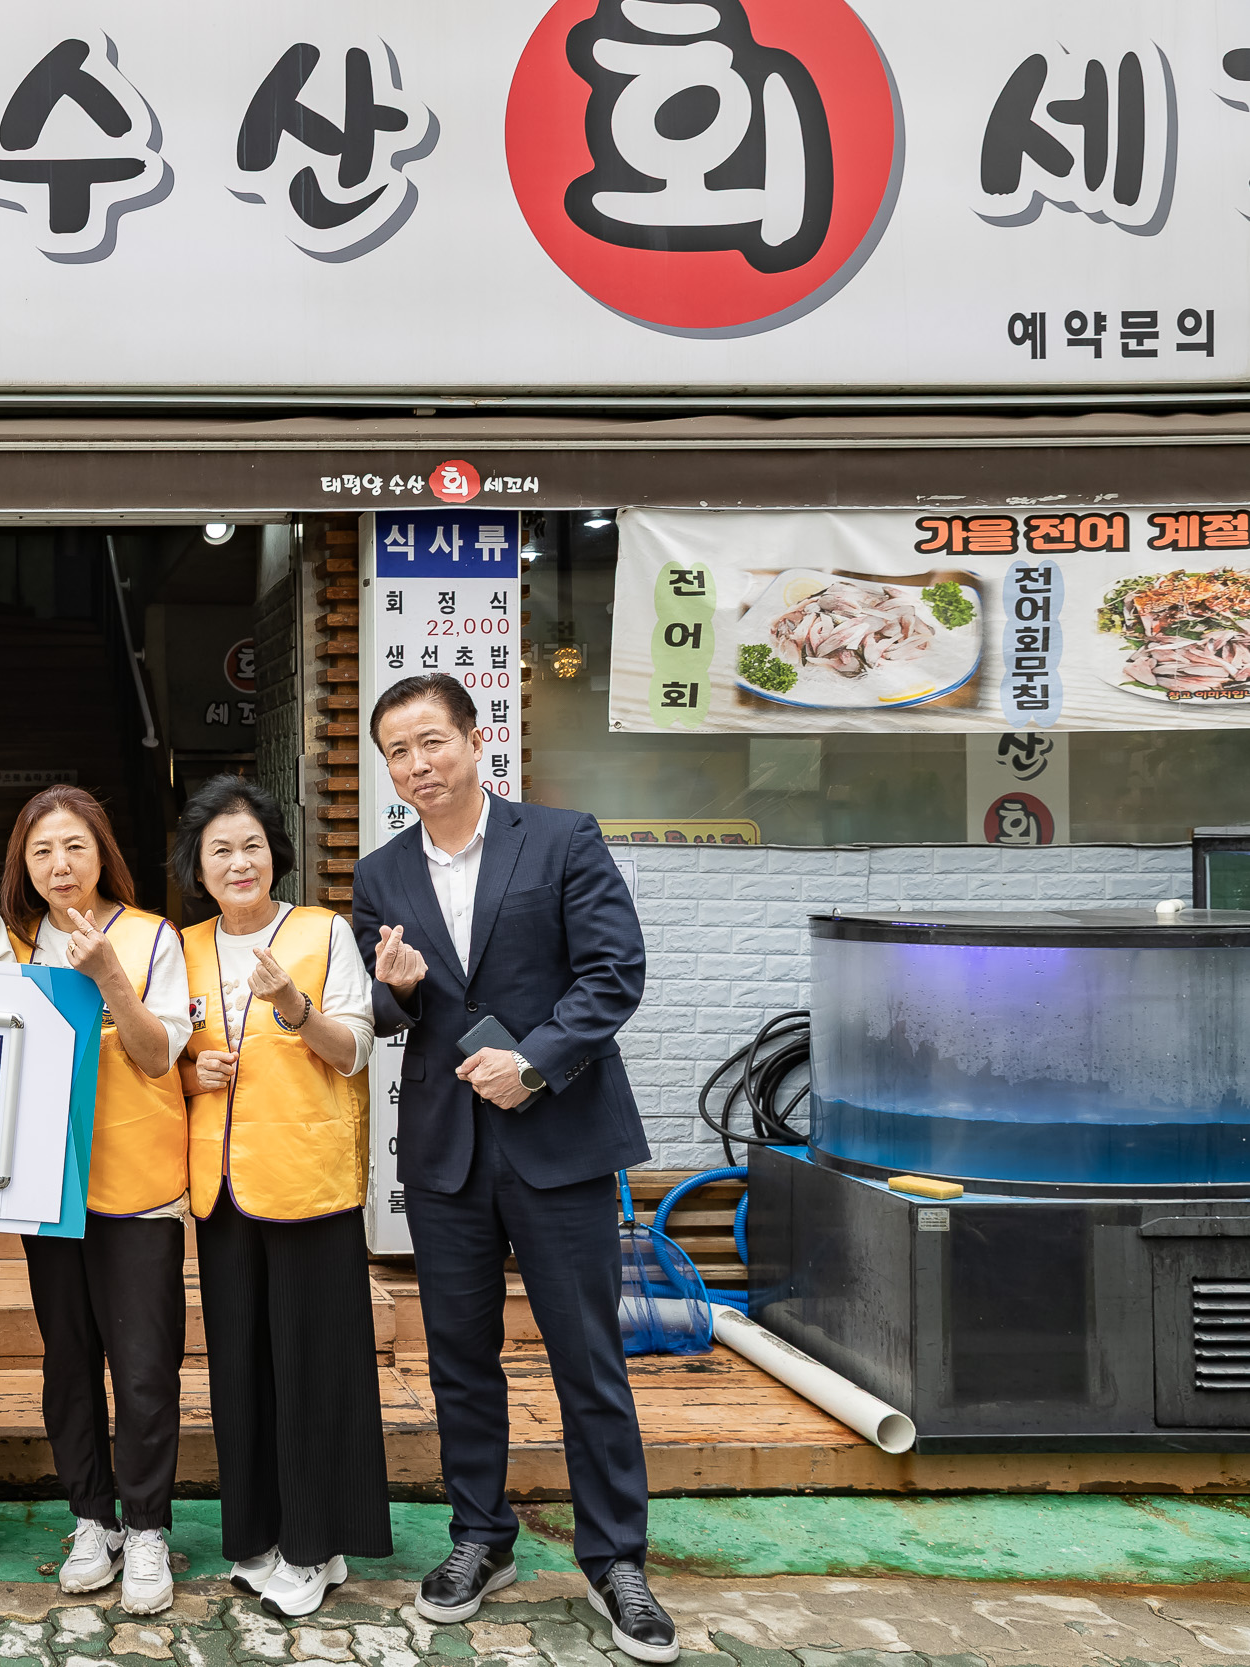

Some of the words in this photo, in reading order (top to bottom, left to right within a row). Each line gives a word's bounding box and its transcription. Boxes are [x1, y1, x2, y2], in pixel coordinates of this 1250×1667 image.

[980, 48, 1250, 208] 세
[1007, 308, 1215, 361] 예약문의
[441, 466, 469, 497] 회
[483, 476, 539, 494] 세꼬시
[383, 524, 509, 562] 식사류
[917, 514, 1016, 555] 가을
[1025, 512, 1130, 552] 전어
[1152, 512, 1250, 549] 계절
[426, 618, 510, 638] 22,000
[1013, 566, 1053, 711] 전어회무침
